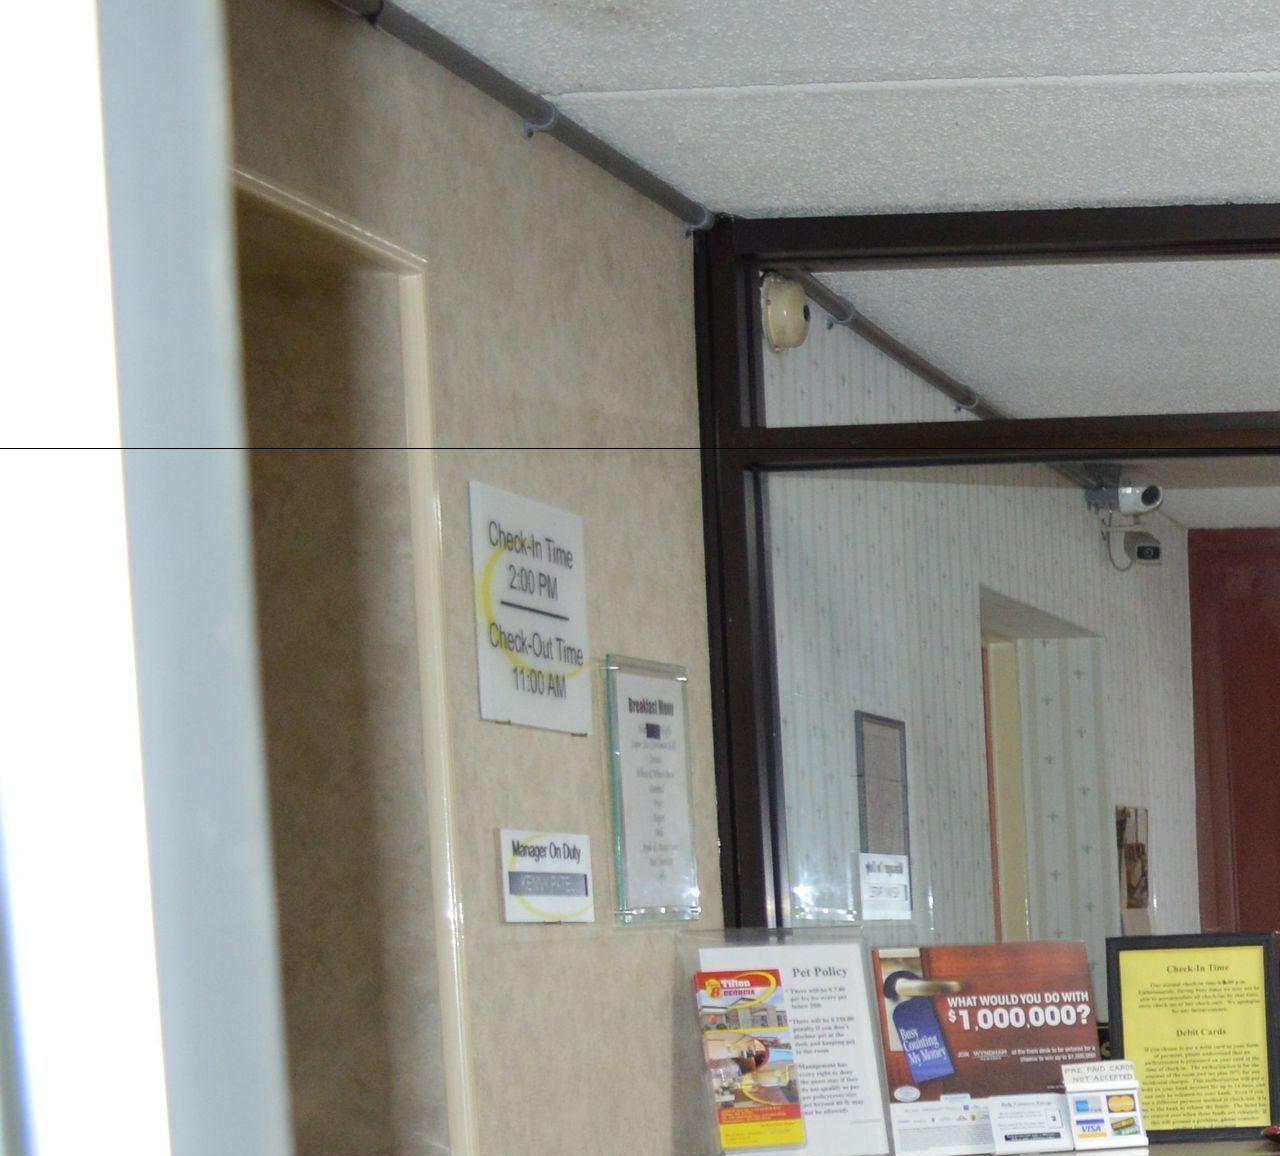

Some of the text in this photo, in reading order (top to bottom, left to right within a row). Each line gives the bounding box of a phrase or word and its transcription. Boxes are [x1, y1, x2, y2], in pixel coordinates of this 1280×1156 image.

[488, 520, 574, 569] Check-In Time
[509, 564, 559, 601] 2:00 PM
[489, 622, 584, 667] Check-Out Time
[512, 666, 567, 700] 11:00 AM
[628, 697, 658, 715] Breakfast
[512, 840, 581, 864] Manager On Duty
[792, 967, 849, 979] Pet Policy
[1166, 963, 1230, 974] Check-In Time
[947, 991, 1089, 1009] WHAT WOULD YOU DO WITH
[948, 1004, 1091, 1032] $1,000,000?
[900, 1026, 919, 1041] Busy
[1176, 1027, 1227, 1038] Debit Cards
[903, 1033, 940, 1052] Counting
[908, 1047, 947, 1068] My Money
[973, 1049, 1008, 1057] WYNDHAM
[1087, 1065, 1106, 1073] PAID
[1109, 1063, 1135, 1072] CARDS
[1072, 1073, 1133, 1084] NOT ACCEPTED
